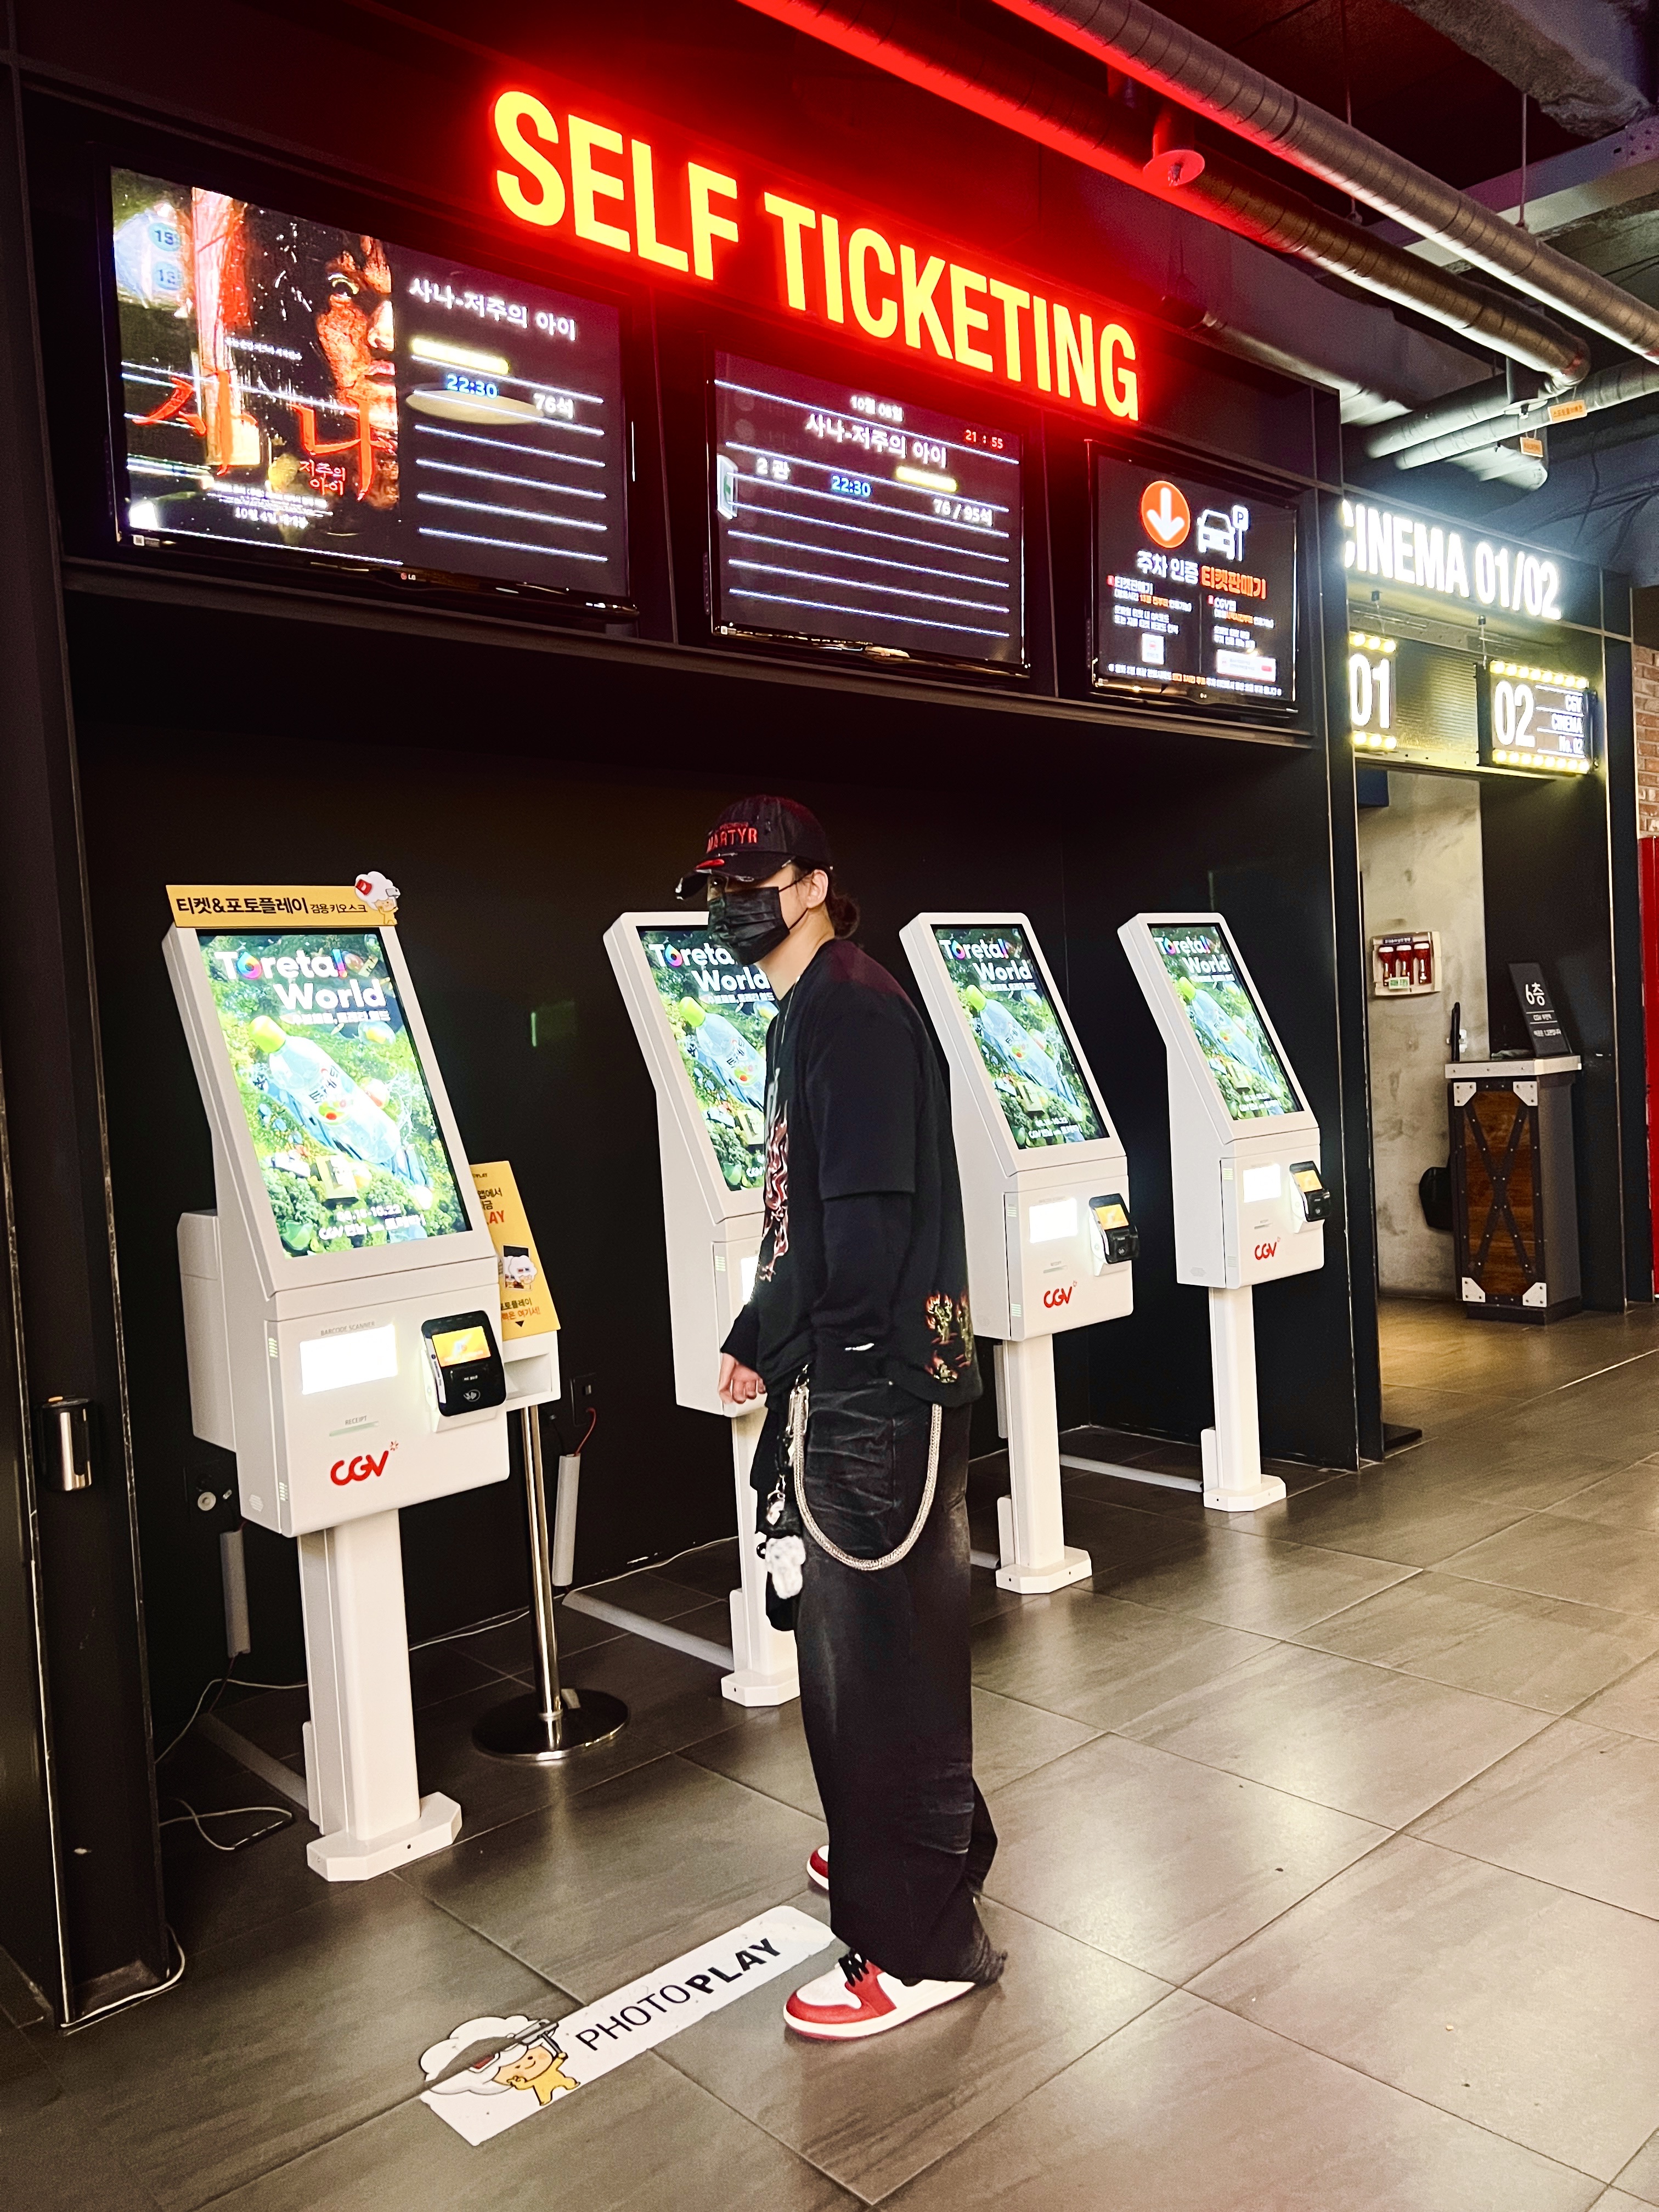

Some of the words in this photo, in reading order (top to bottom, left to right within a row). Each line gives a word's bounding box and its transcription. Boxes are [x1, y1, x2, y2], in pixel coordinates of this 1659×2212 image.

[494, 91, 740, 280] SELF
[764, 191, 1139, 421] TICKETING
[409, 278, 528, 329] 사나-저주의
[535, 312, 576, 341] 아이
[446, 374, 499, 399] 22:30
[534, 392, 575, 419] 76석
[806, 413, 906, 459] 사나-저주의
[912, 441, 947, 468] 아이
[756, 458, 769, 475] 2
[309, 477, 344, 496] 아이
[831, 475, 872, 498] 22:30
[933, 498, 952, 516] 76
[1237, 511, 1244, 523] P
[1341, 499, 1470, 598] CINEMA
[1475, 541, 1561, 620] 01/02
[1137, 550, 1169, 578] 주차
[1170, 557, 1199, 585] 인증
[1201, 565, 1266, 600] 티켓판매기
[1349, 653, 1391, 729] 01
[1494, 680, 1536, 748] 02
[1565, 693, 1583, 713] CGV
[1551, 713, 1583, 734] CINEMA
[1573, 737, 1584, 754] 02
[706, 827, 758, 854] MARTYR
[176, 896, 309, 915] 티켓&포토플레이
[329, 904, 368, 915] 키오스크
[939, 939, 1009, 960] Toreta!
[1154, 935, 1211, 956] Toreta!
[214, 947, 348, 980] Toreta!
[972, 959, 1033, 981] World
[1182, 953, 1232, 974] World
[692, 966, 771, 992] World
[273, 978, 387, 1011] World
[1525, 982, 1545, 1006] 6층
[487, 1210, 505, 1224] AY
[1254, 1241, 1277, 1261] CGV
[1043, 1285, 1073, 1308] CGV
[320, 1325, 347, 1336] BARCODE
[348, 1321, 376, 1331] SCANNER
[345, 1415, 368, 1426] RECEIPT
[330, 1449, 390, 1487] CGV
[575, 1937, 783, 2052] PHOTOPLAY
